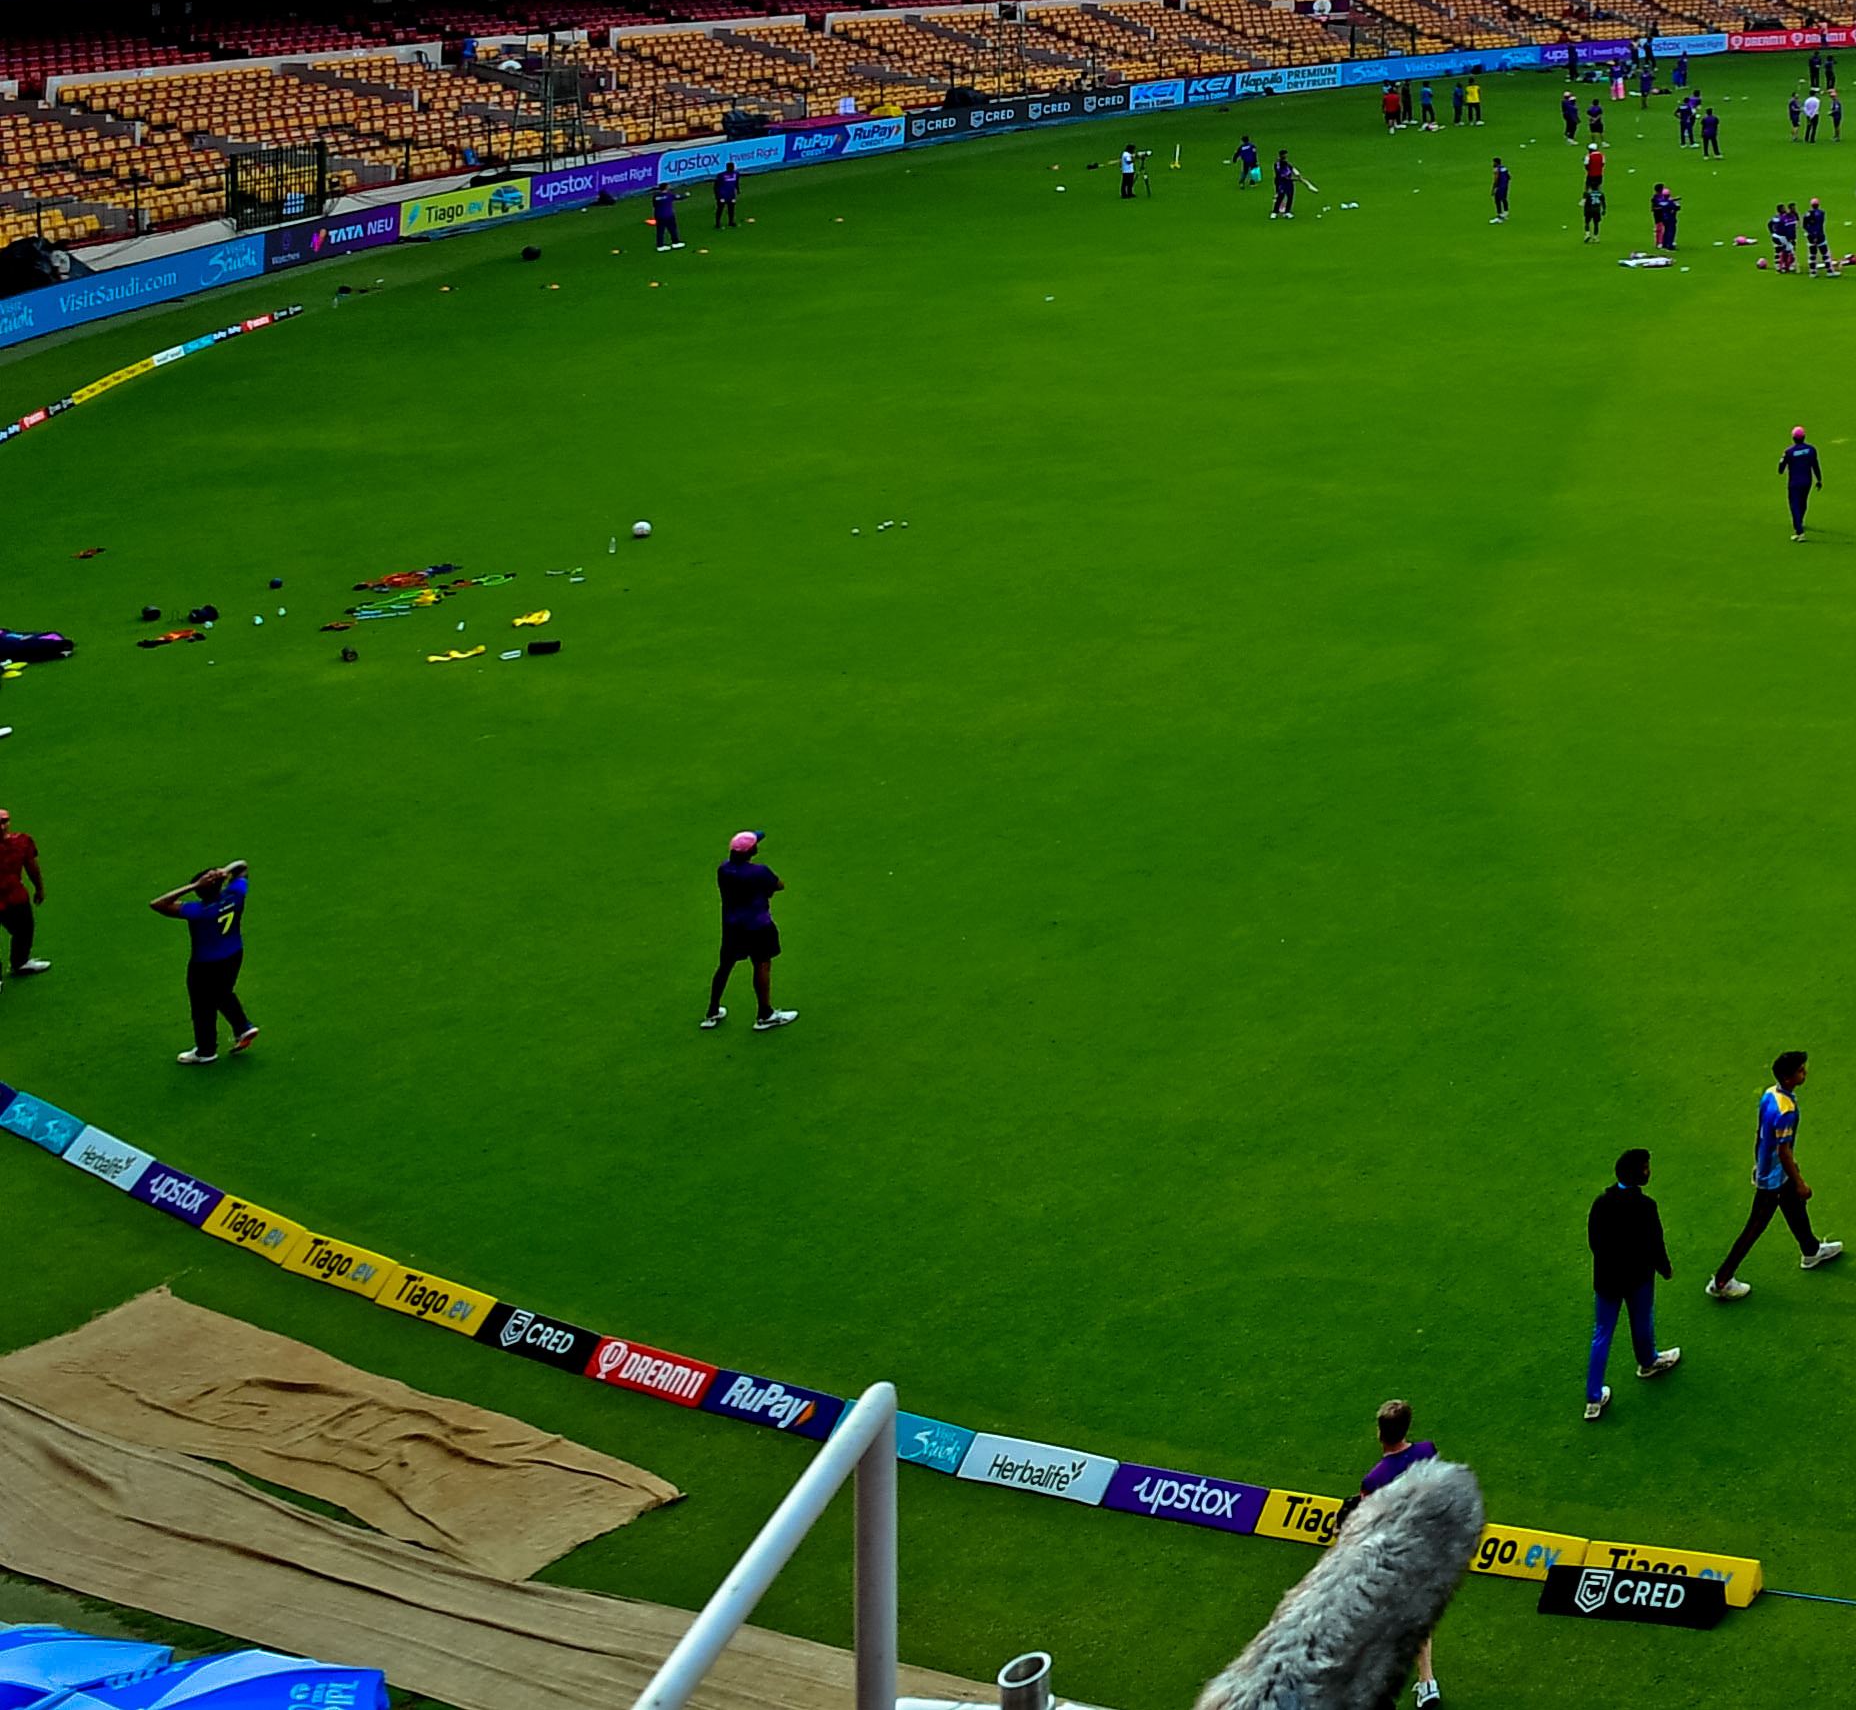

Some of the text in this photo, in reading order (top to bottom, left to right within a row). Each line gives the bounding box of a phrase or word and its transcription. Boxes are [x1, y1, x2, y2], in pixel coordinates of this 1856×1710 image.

[1187, 76, 1232, 94] KEI
[1239, 75, 1282, 92] Happilo
[1286, 66, 1336, 80] PREMIUM
[1286, 77, 1336, 89] DRY FRUITS
[985, 109, 1015, 122] CRED
[1043, 102, 1071, 114] CRED
[1098, 94, 1125, 107] CRED
[852, 124, 895, 141] RuPay
[927, 117, 957, 131] CRED
[792, 132, 838, 151] RuPay
[664, 153, 721, 176] upstox
[757, 145, 779, 160] Right
[535, 166, 653, 202] upstox Invest Right
[425, 203, 463, 223] Tiago
[328, 216, 394, 245] TATA NEU
[59, 272, 177, 314] VisitSaudi.com
[217, 910, 235, 935] 7
[149, 1172, 210, 1215] upstox
[219, 1201, 287, 1251] Tiago.ev
[301, 1238, 378, 1286] Tiago.ev
[395, 1275, 476, 1323] Tiago.ev
[524, 1321, 576, 1354] CRED
[620, 1355, 707, 1400] DREAM11
[720, 1376, 808, 1429] RuPay
[988, 1453, 1071, 1492] Herbalife
[1133, 1475, 1241, 1519] upstox
[1614, 1578, 1685, 1609] CRED
